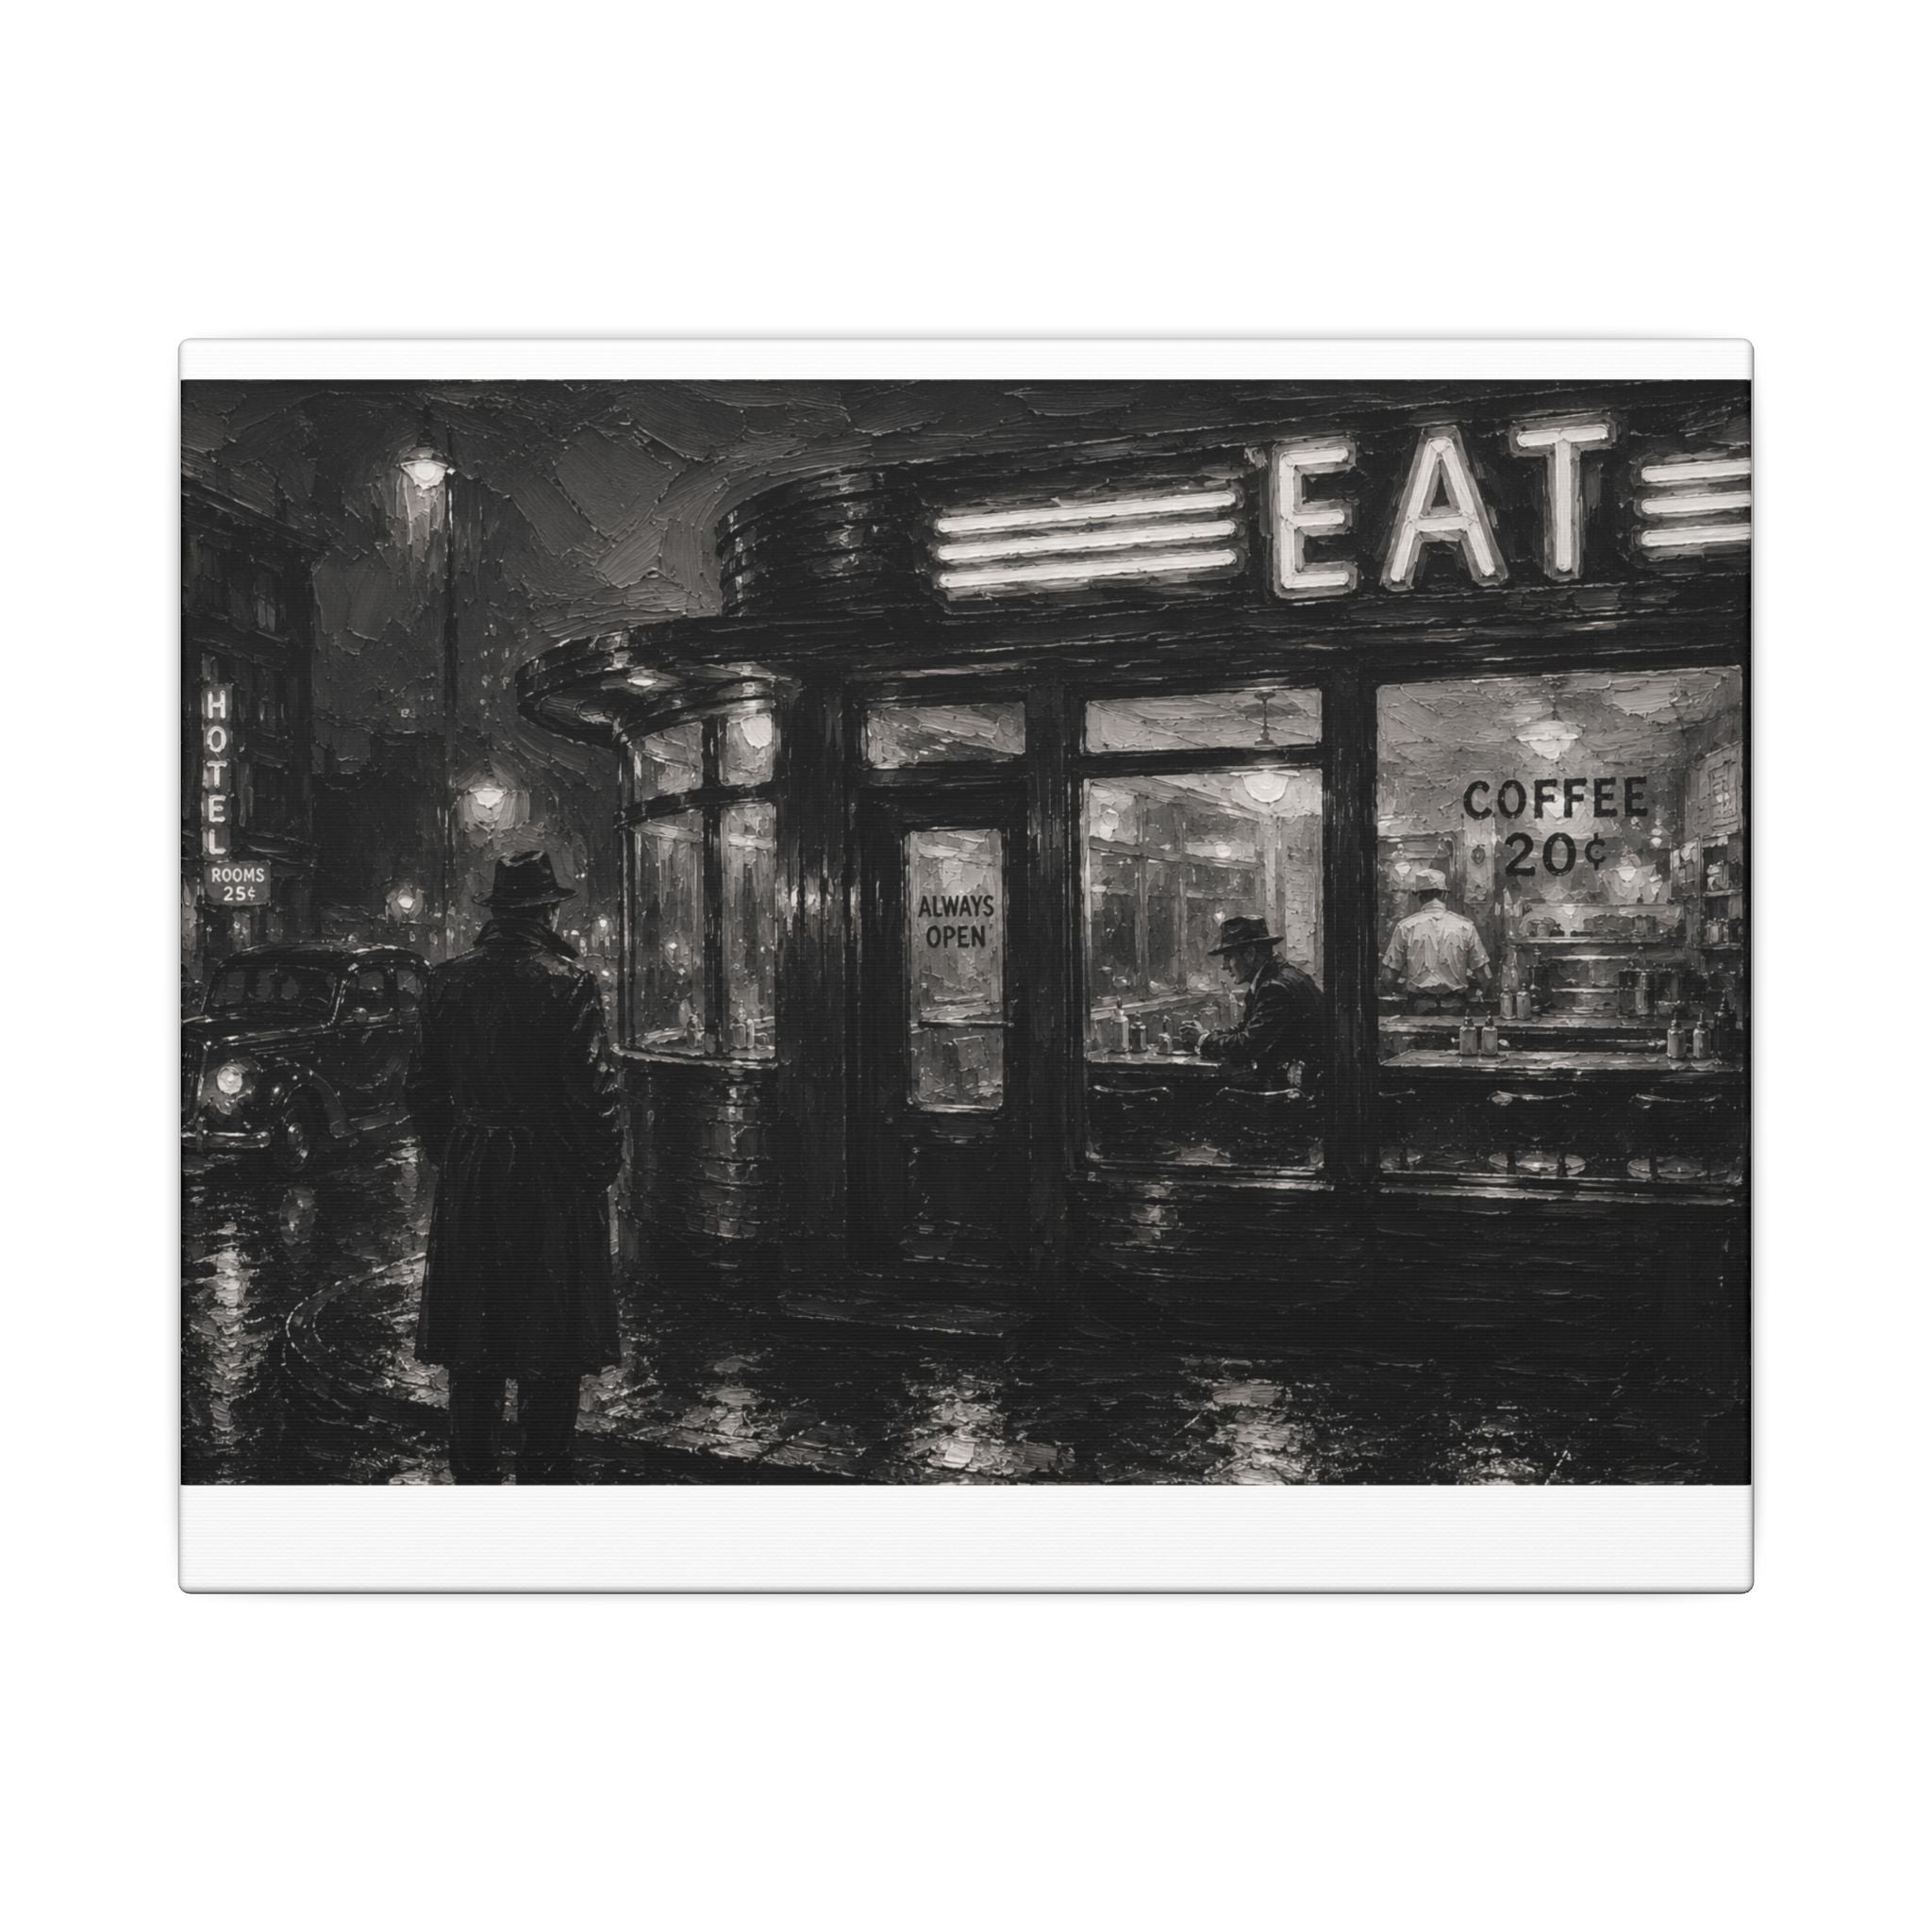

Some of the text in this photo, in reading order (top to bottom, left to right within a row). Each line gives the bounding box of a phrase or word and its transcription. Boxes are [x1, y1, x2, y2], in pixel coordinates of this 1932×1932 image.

[1275, 421, 1611, 592] EAT
[207, 690, 228, 855] HOTEL
[1463, 776, 1649, 820] COFFEE
[1505, 832, 1607, 876] 20¢
[211, 867, 265, 883] ROOMS
[223, 886, 256, 901] 25¢
[918, 895, 994, 918] ALWAYS
[925, 925, 986, 948] OPEN
